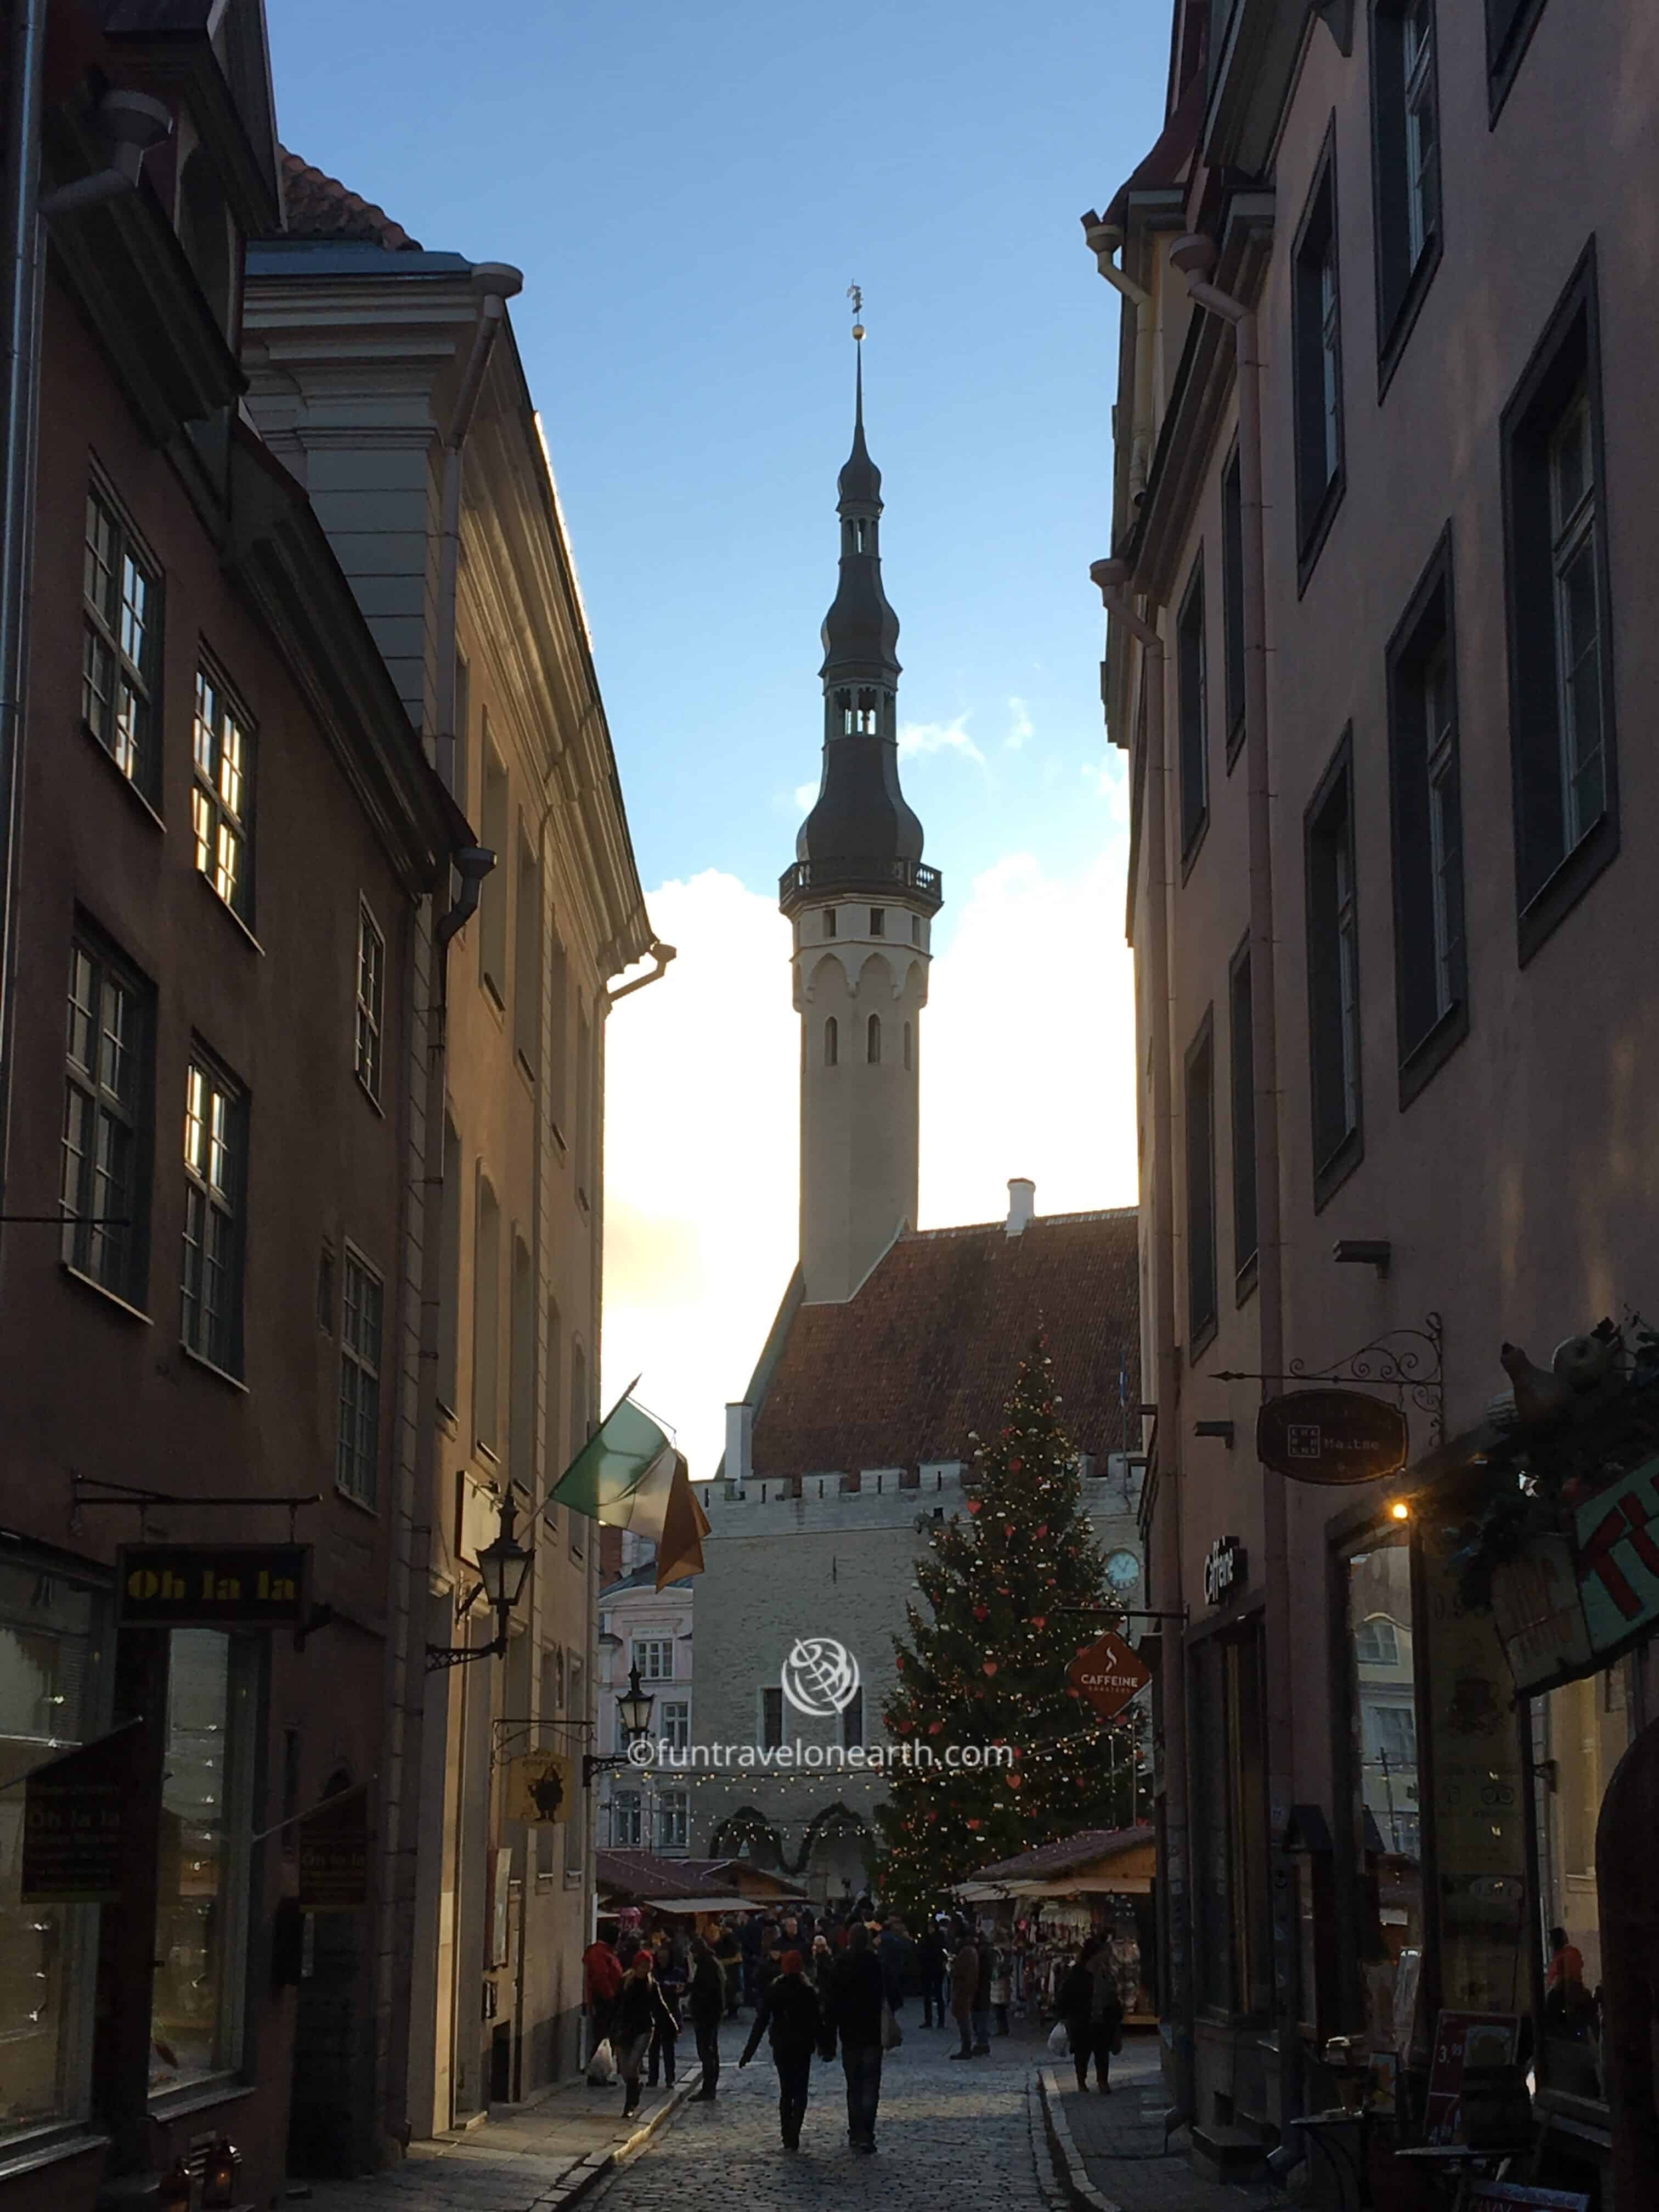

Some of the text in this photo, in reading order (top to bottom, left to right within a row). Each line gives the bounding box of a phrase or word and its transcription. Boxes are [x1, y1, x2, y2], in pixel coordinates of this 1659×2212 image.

[127, 1569, 295, 1600] Oh la la
[1080, 1673, 1139, 1688] CAFFEINE
